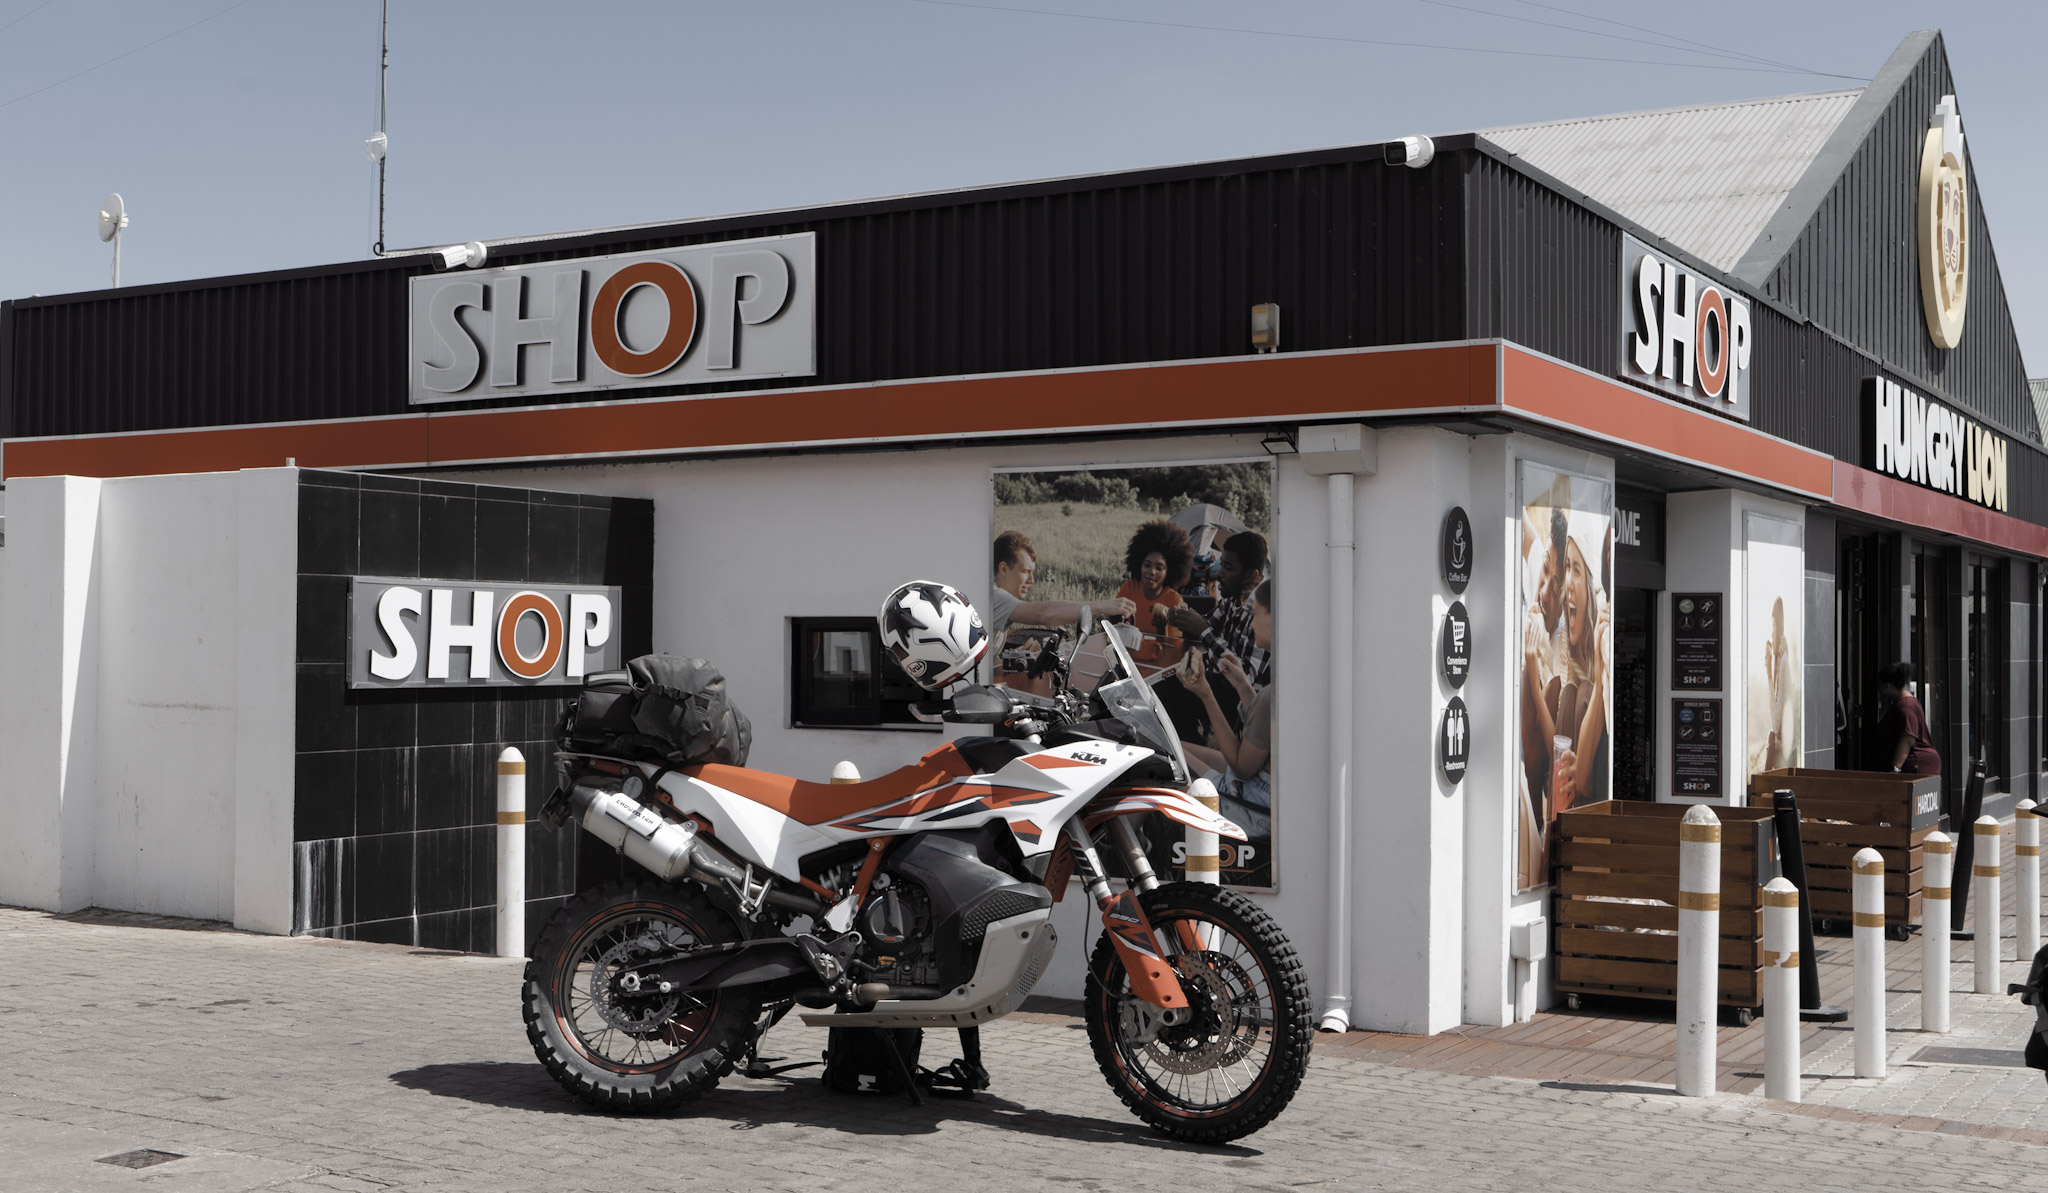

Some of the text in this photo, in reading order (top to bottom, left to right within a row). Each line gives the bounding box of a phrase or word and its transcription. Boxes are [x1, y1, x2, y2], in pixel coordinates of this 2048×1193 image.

[422, 249, 789, 393] SHOP
[1634, 254, 1752, 404] SHOP
[1876, 375, 2008, 512] HUNGRY LION
[1448, 572, 1468, 583] Coffee Bar
[370, 586, 613, 680] SHOP
[1446, 656, 1468, 666] Convenience
[1452, 665, 1462, 675] Store
[1683, 675, 1711, 684] SHOP
[1070, 751, 1108, 766] KTM
[1445, 761, 1466, 771] Restrooms
[1683, 782, 1711, 791] SHOP
[1915, 791, 1938, 816] CHARCOAL
[1171, 841, 1256, 868] SOP
